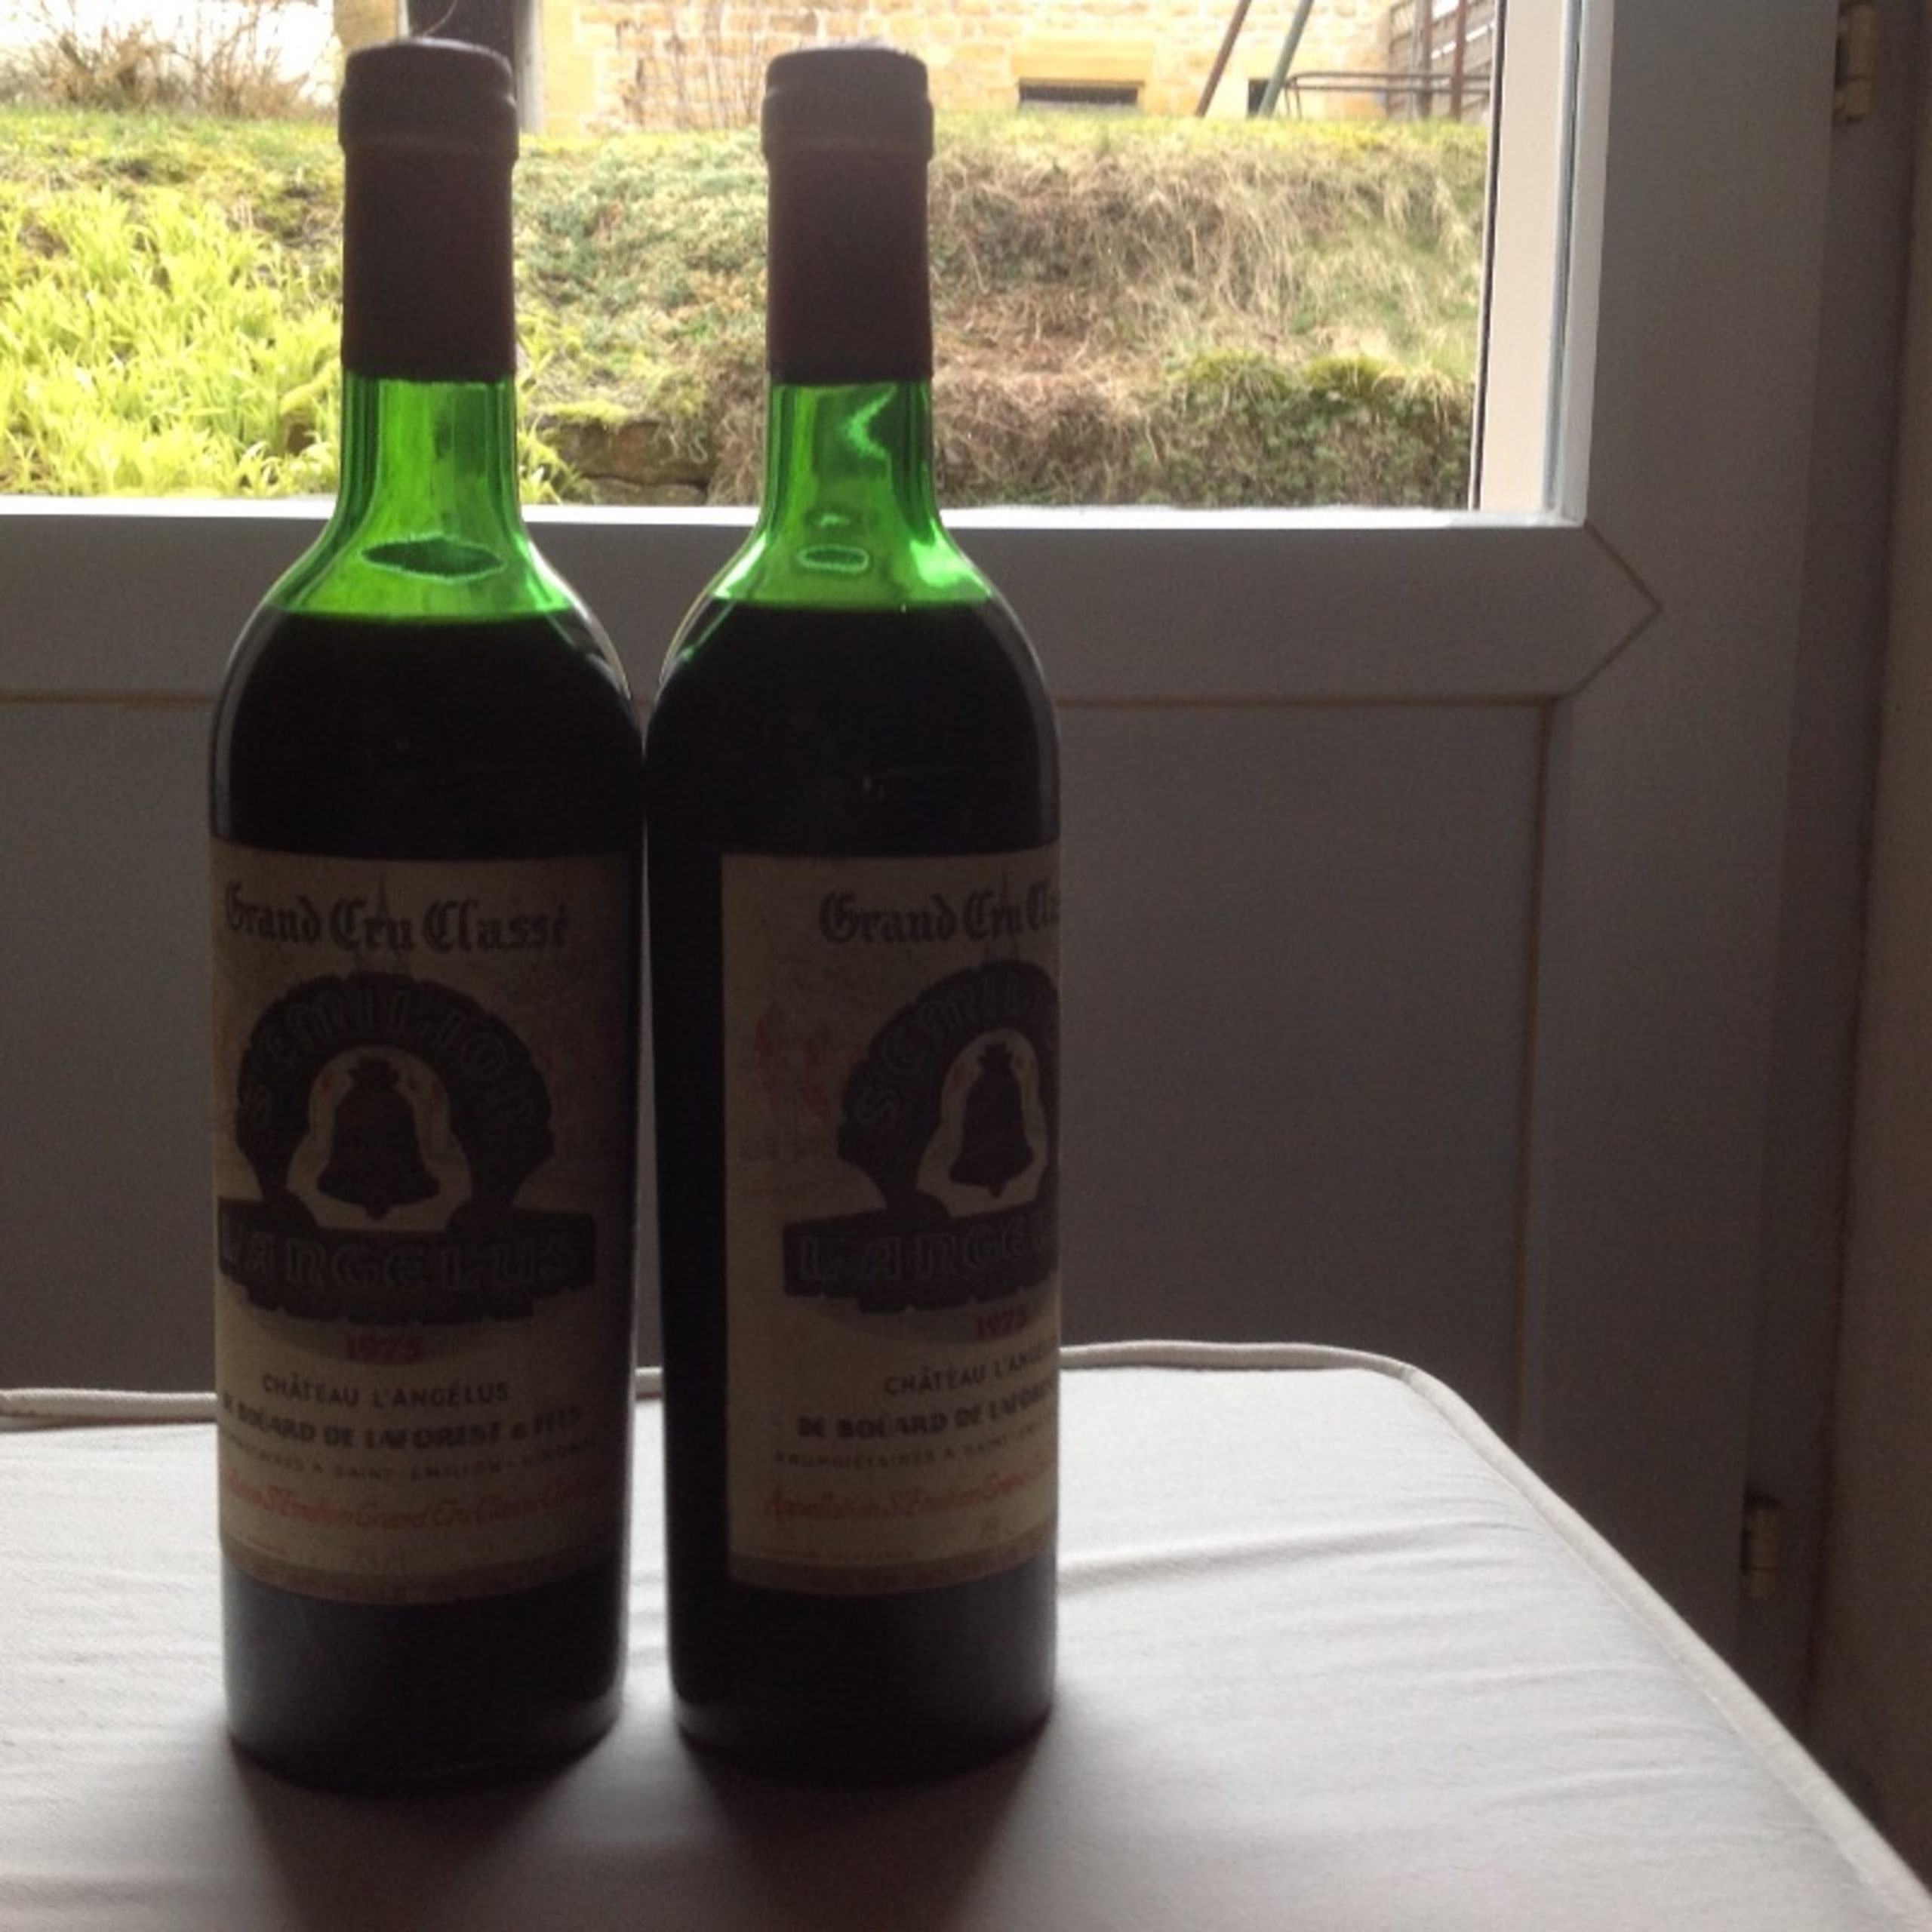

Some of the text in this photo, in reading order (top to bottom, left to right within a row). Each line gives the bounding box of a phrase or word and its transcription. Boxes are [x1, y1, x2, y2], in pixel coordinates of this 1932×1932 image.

[226, 881, 321, 946] Grand
[330, 896, 416, 952] Cru
[818, 890, 957, 944] Grand
[962, 884, 1023, 941] Cru
